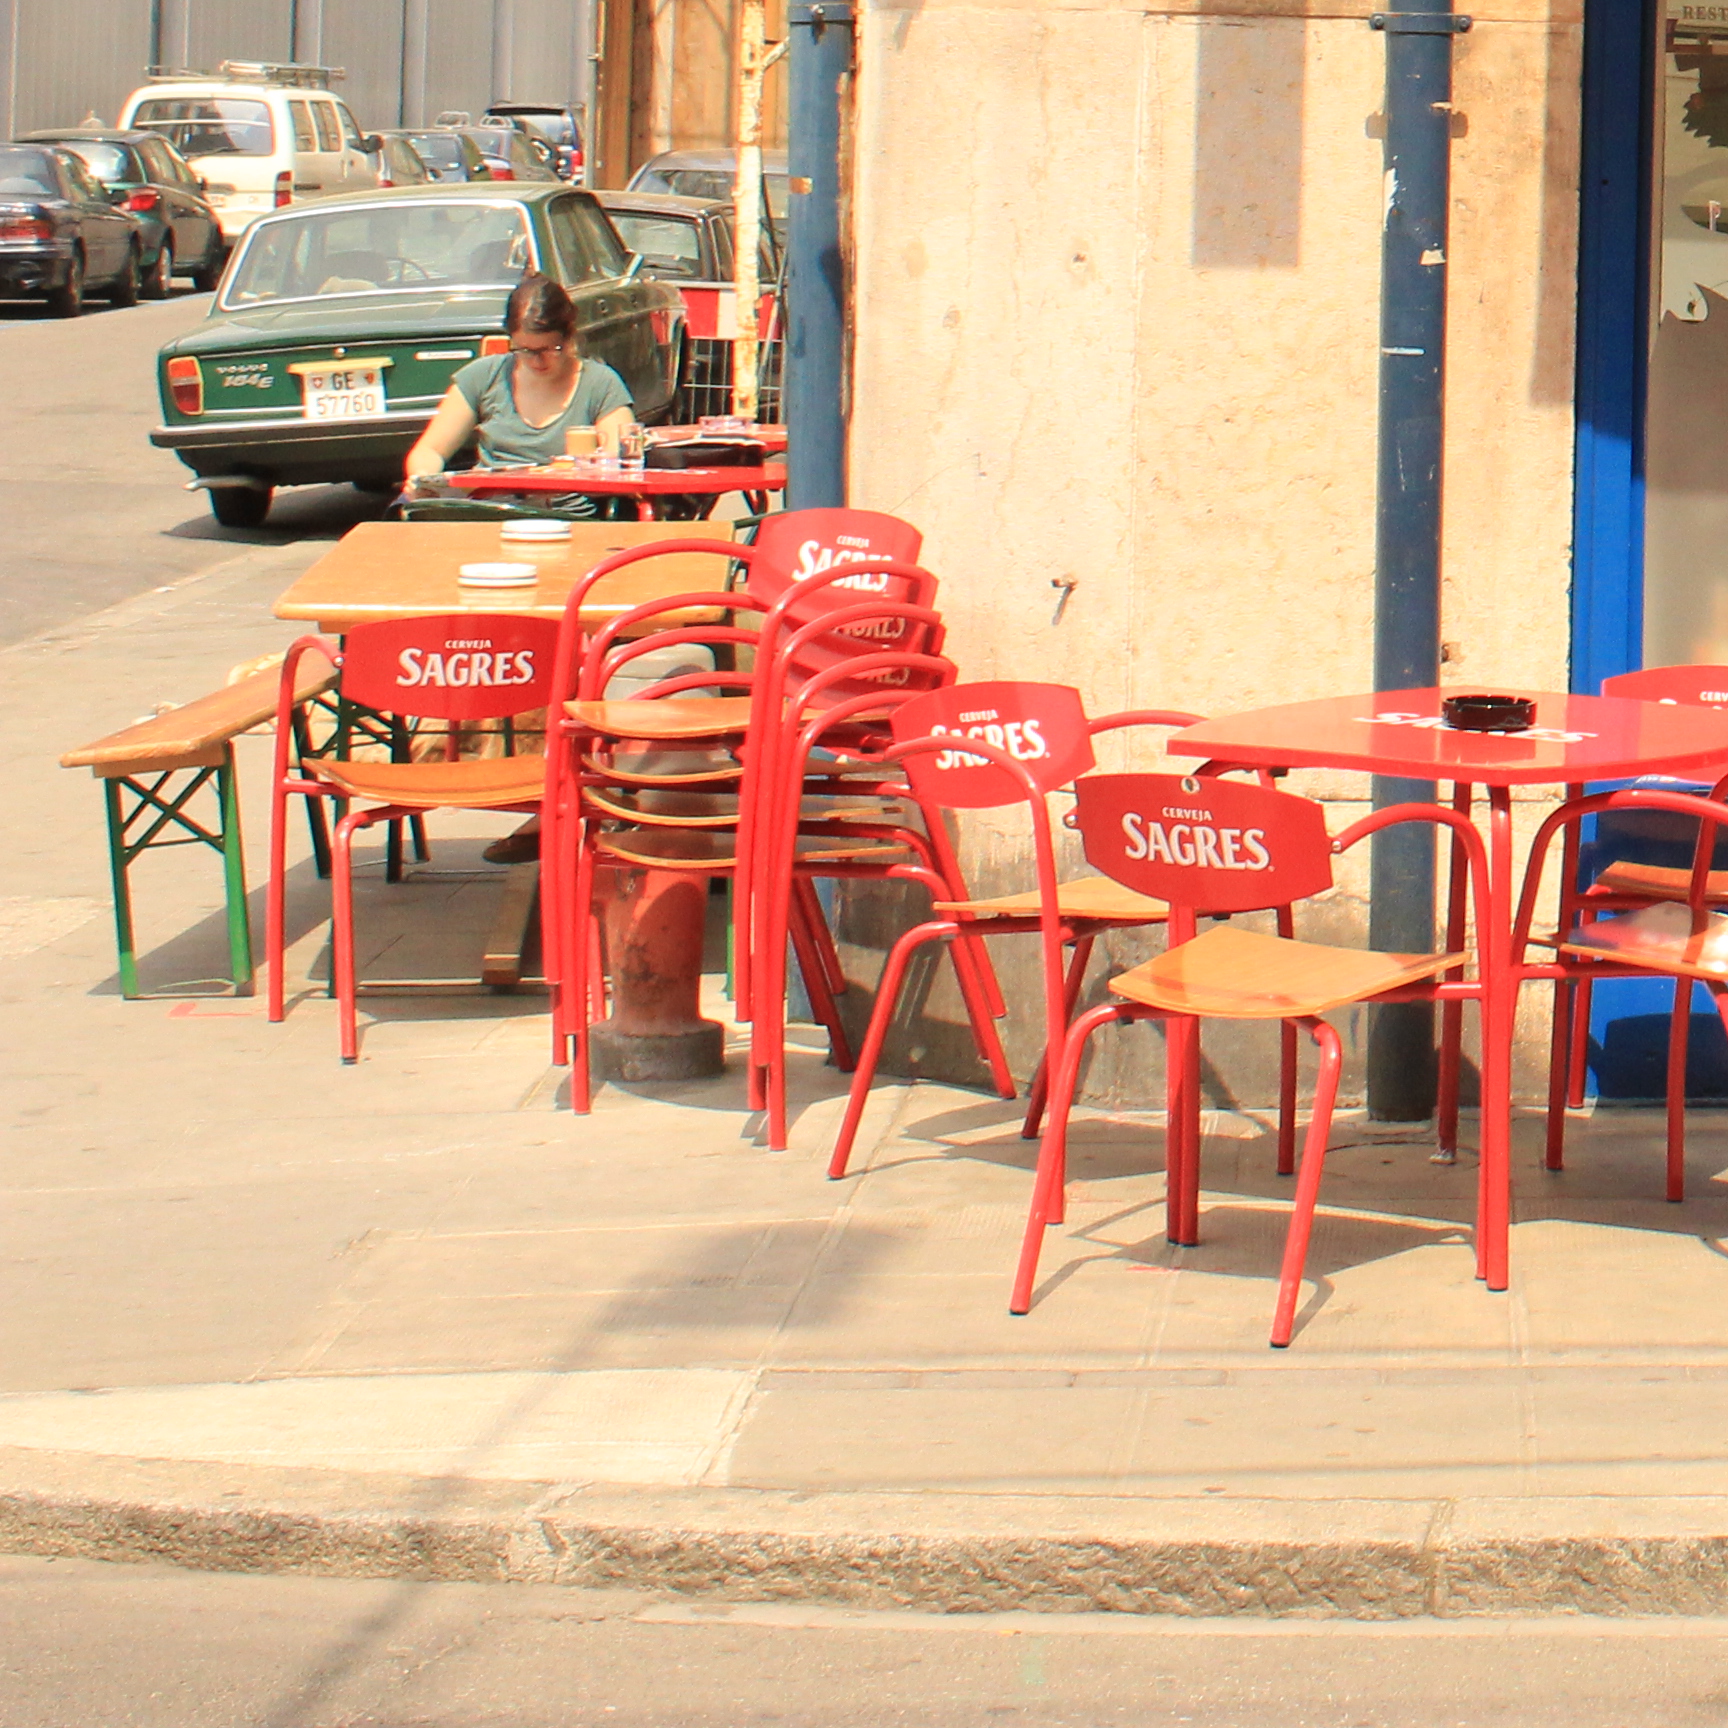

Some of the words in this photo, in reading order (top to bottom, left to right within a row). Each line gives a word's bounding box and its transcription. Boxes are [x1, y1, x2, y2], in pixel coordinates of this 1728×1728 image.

[331, 373, 355, 390] GE
[836, 535, 870, 548] CERVEJA
[444, 639, 492, 650] CERVEJA
[396, 648, 535, 687] SAGRES
[959, 709, 998, 722] CERVEJA
[1162, 806, 1213, 822] CERVEJA
[1122, 812, 1270, 872] SAGRES
